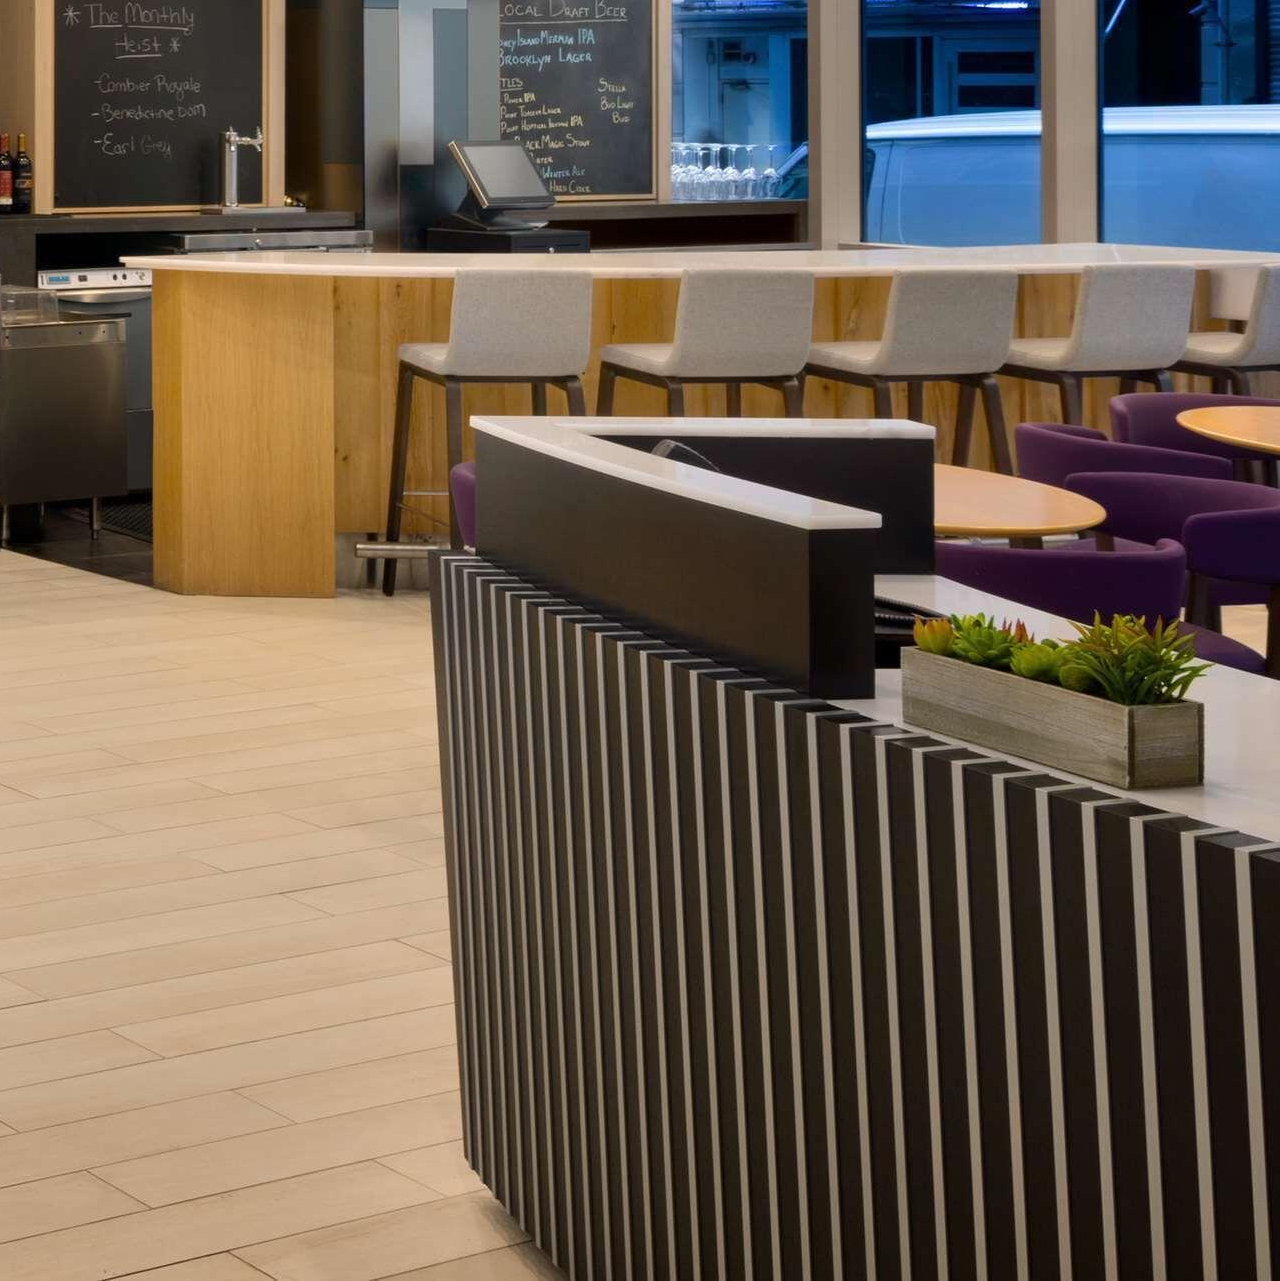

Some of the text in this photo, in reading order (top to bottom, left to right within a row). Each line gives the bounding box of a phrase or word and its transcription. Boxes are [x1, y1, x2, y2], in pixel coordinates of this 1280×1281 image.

[84, 2, 194, 35] The Monthly
[577, 27, 596, 45] IPA
[559, 46, 593, 63] LAGER
[153, 74, 201, 102] Royale
